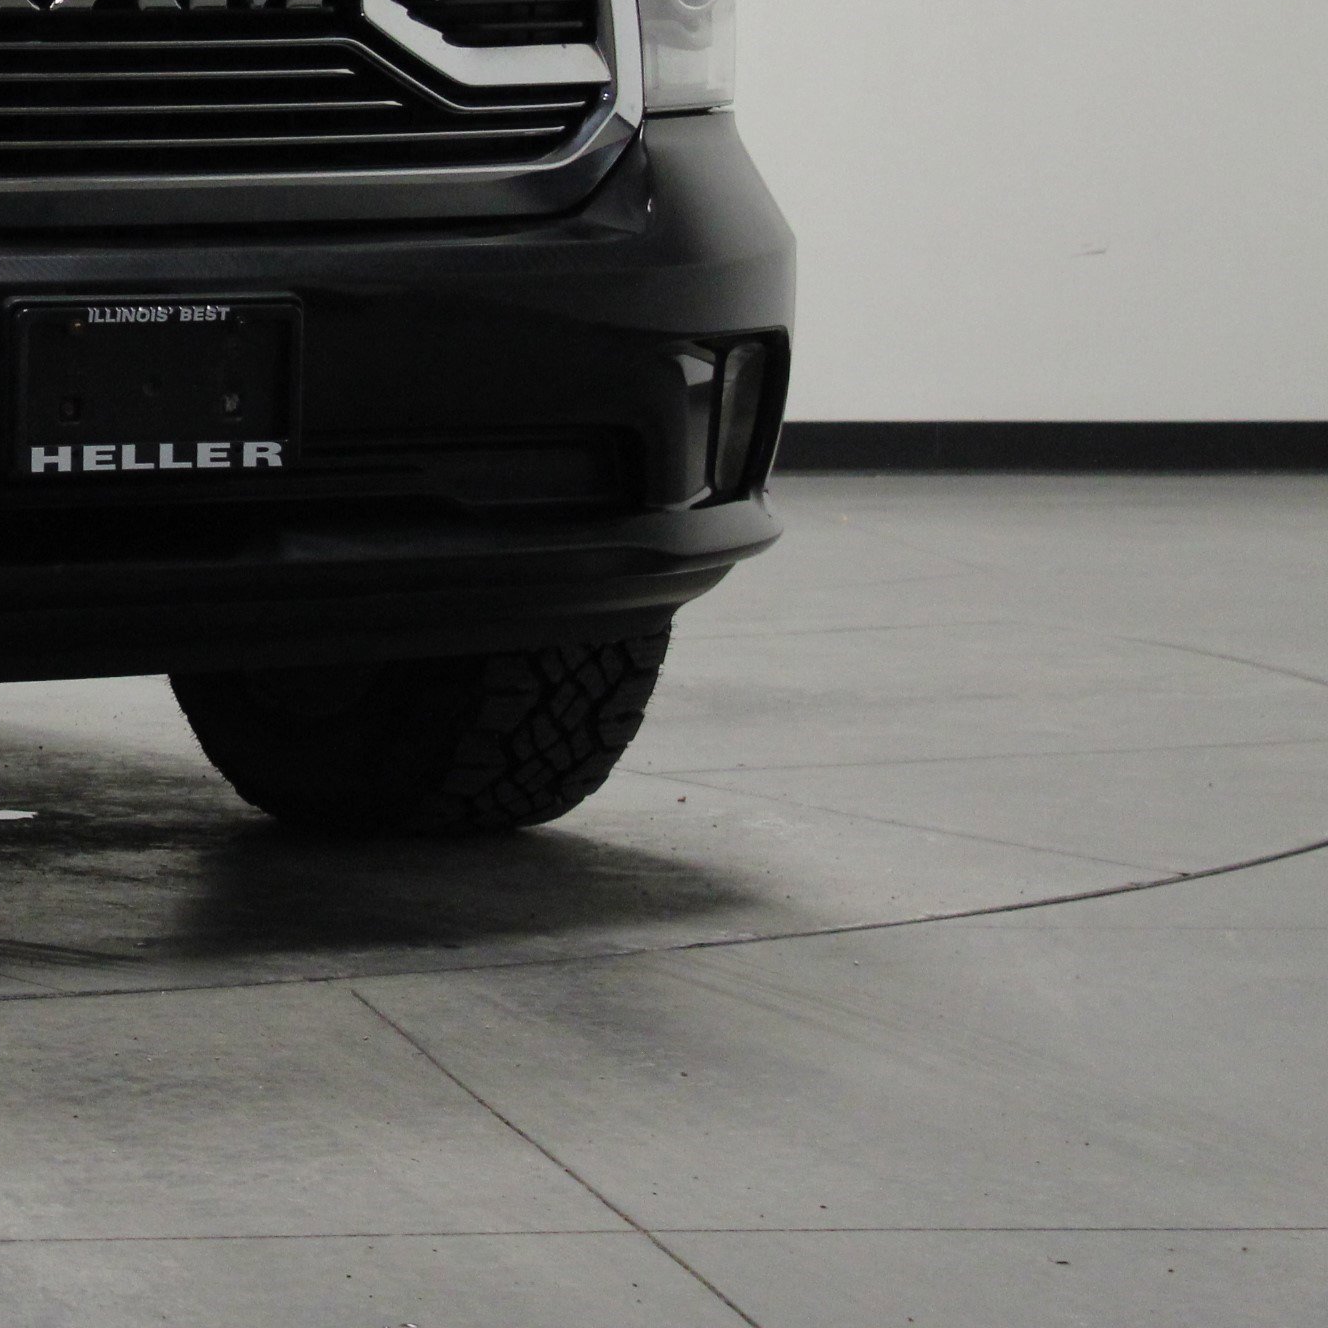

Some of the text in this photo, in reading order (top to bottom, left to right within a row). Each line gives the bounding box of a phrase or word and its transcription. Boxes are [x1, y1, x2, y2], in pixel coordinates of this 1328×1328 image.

[87, 305, 231, 323] ILLINOIS' BEST
[31, 441, 283, 473] HELLER
